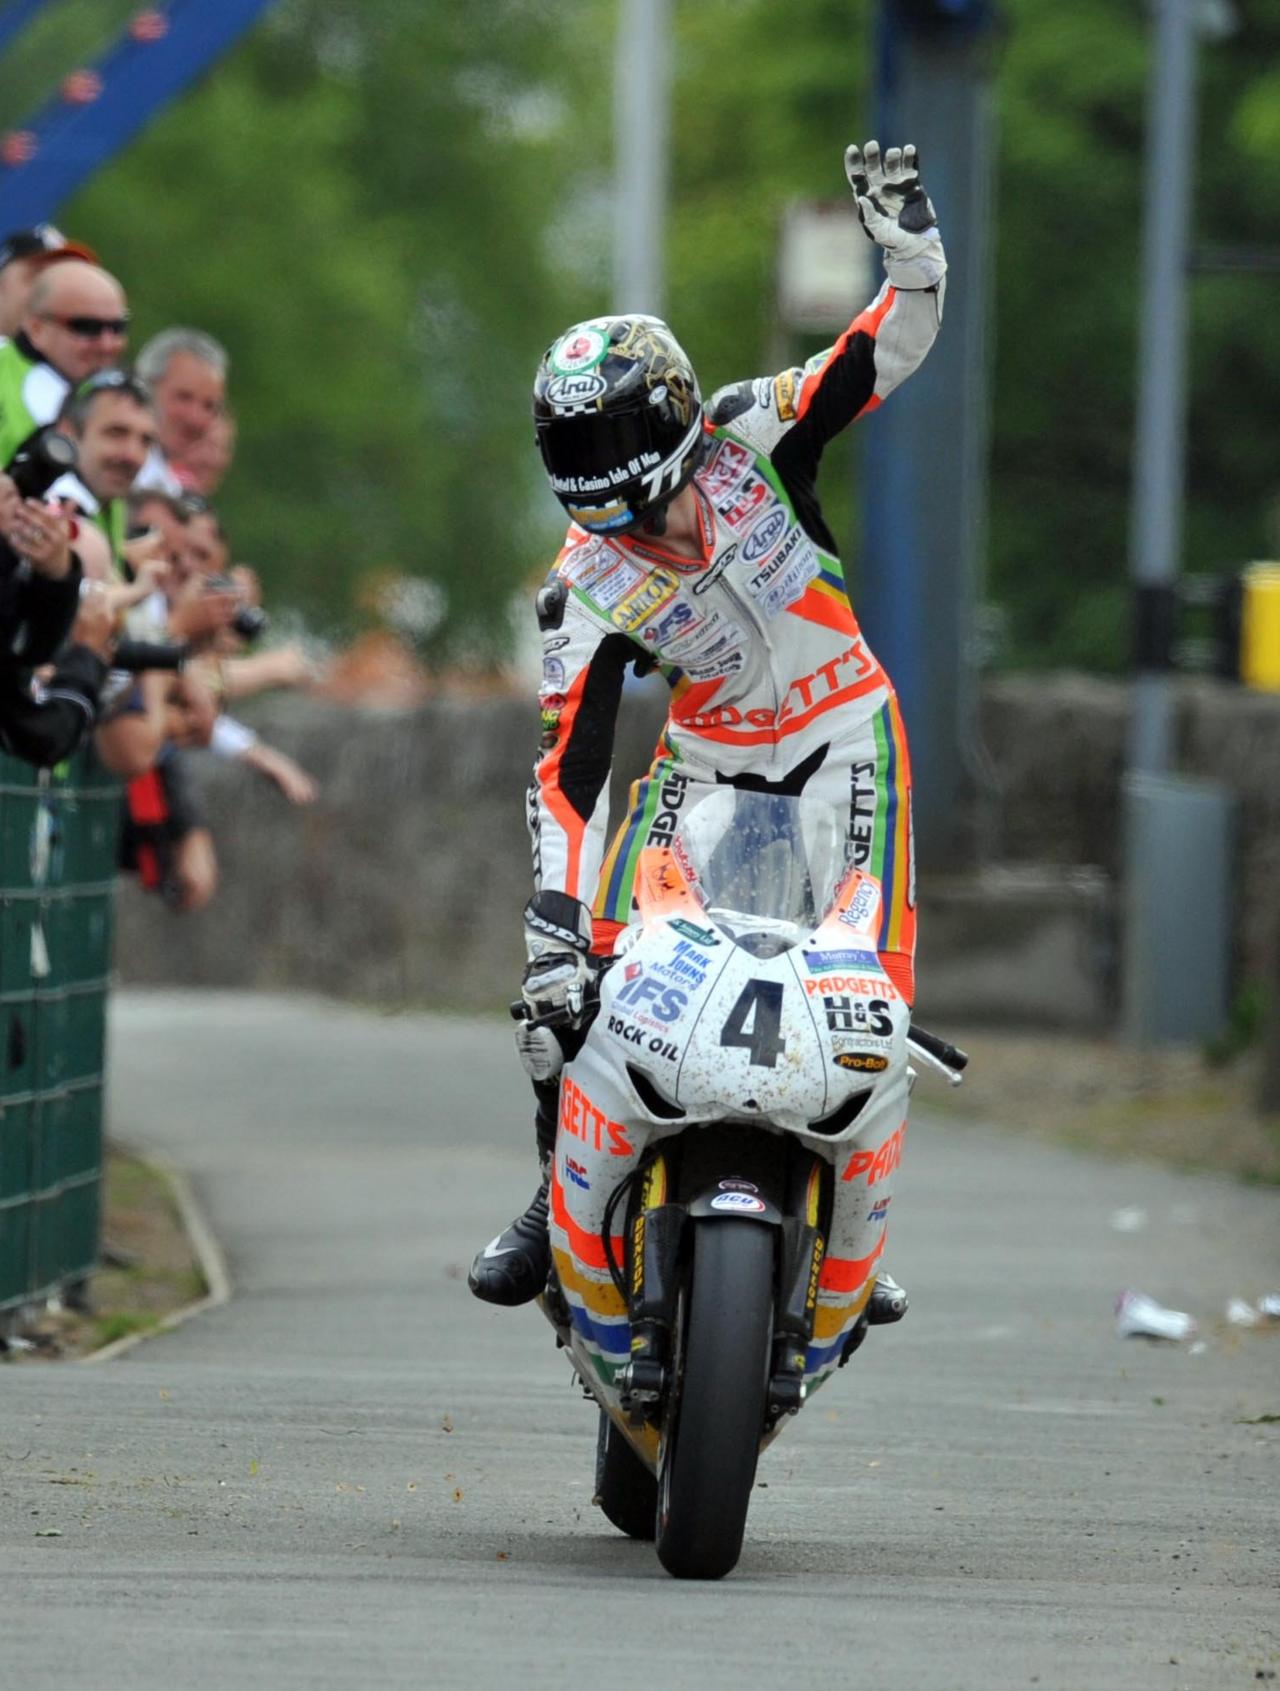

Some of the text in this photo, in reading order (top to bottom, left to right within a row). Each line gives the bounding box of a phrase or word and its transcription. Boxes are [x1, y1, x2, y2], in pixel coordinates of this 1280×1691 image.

[549, 377, 596, 397] Arai
[578, 475, 611, 492] Casino
[608, 467, 630, 485] Isle
[628, 458, 641, 475] Of
[640, 451, 660, 469] Man
[706, 445, 743, 493] NGK
[748, 511, 785, 558] Arai
[751, 528, 802, 588] TSUBAKI
[838, 881, 879, 928] Regency
[668, 955, 707, 984] JOHNS
[673, 940, 712, 969] MARK
[820, 951, 867, 962] Murray's
[650, 962, 702, 991] Motors
[804, 976, 897, 1000] PADGETTS
[615, 977, 688, 1022] IFS
[823, 995, 894, 1037] H&S
[607, 1014, 680, 1062] ROCK OIL
[632, 1011, 669, 1034] Logistics
[720, 978, 786, 1068] 4
